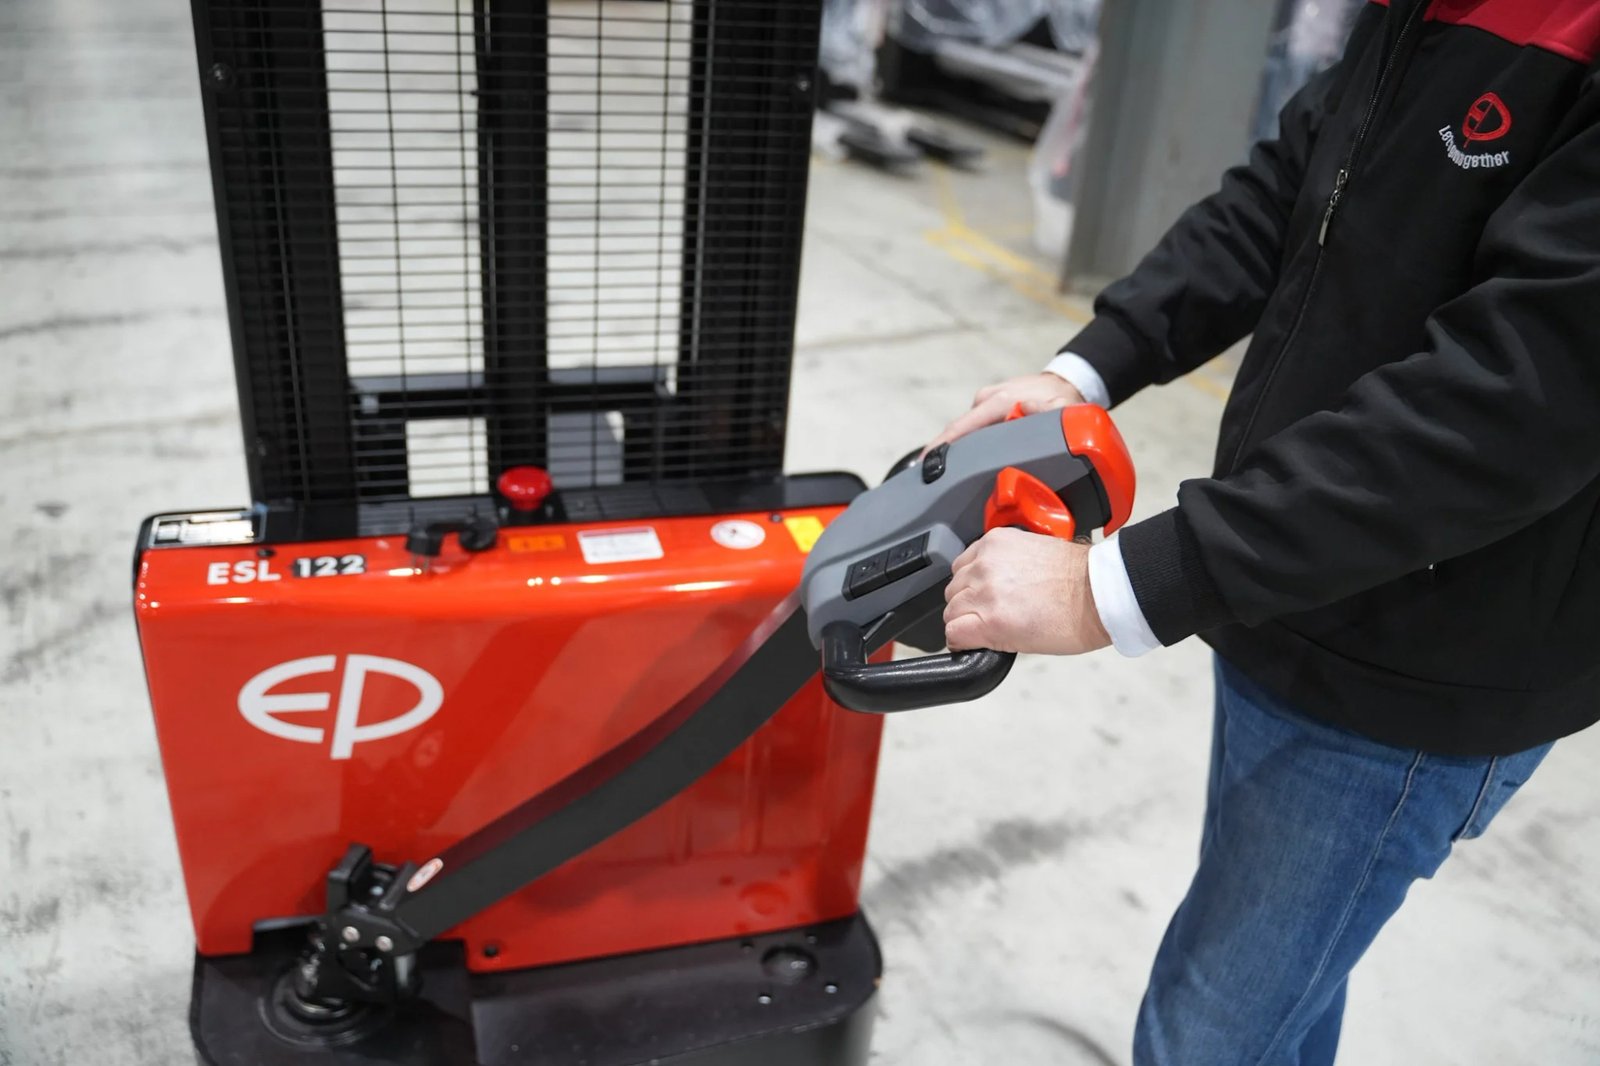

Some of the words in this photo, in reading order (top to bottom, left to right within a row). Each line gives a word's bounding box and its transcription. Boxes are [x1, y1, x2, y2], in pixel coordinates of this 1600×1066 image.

[207, 559, 282, 585] ESL
[296, 554, 364, 578] 122
[237, 654, 444, 760] EP
